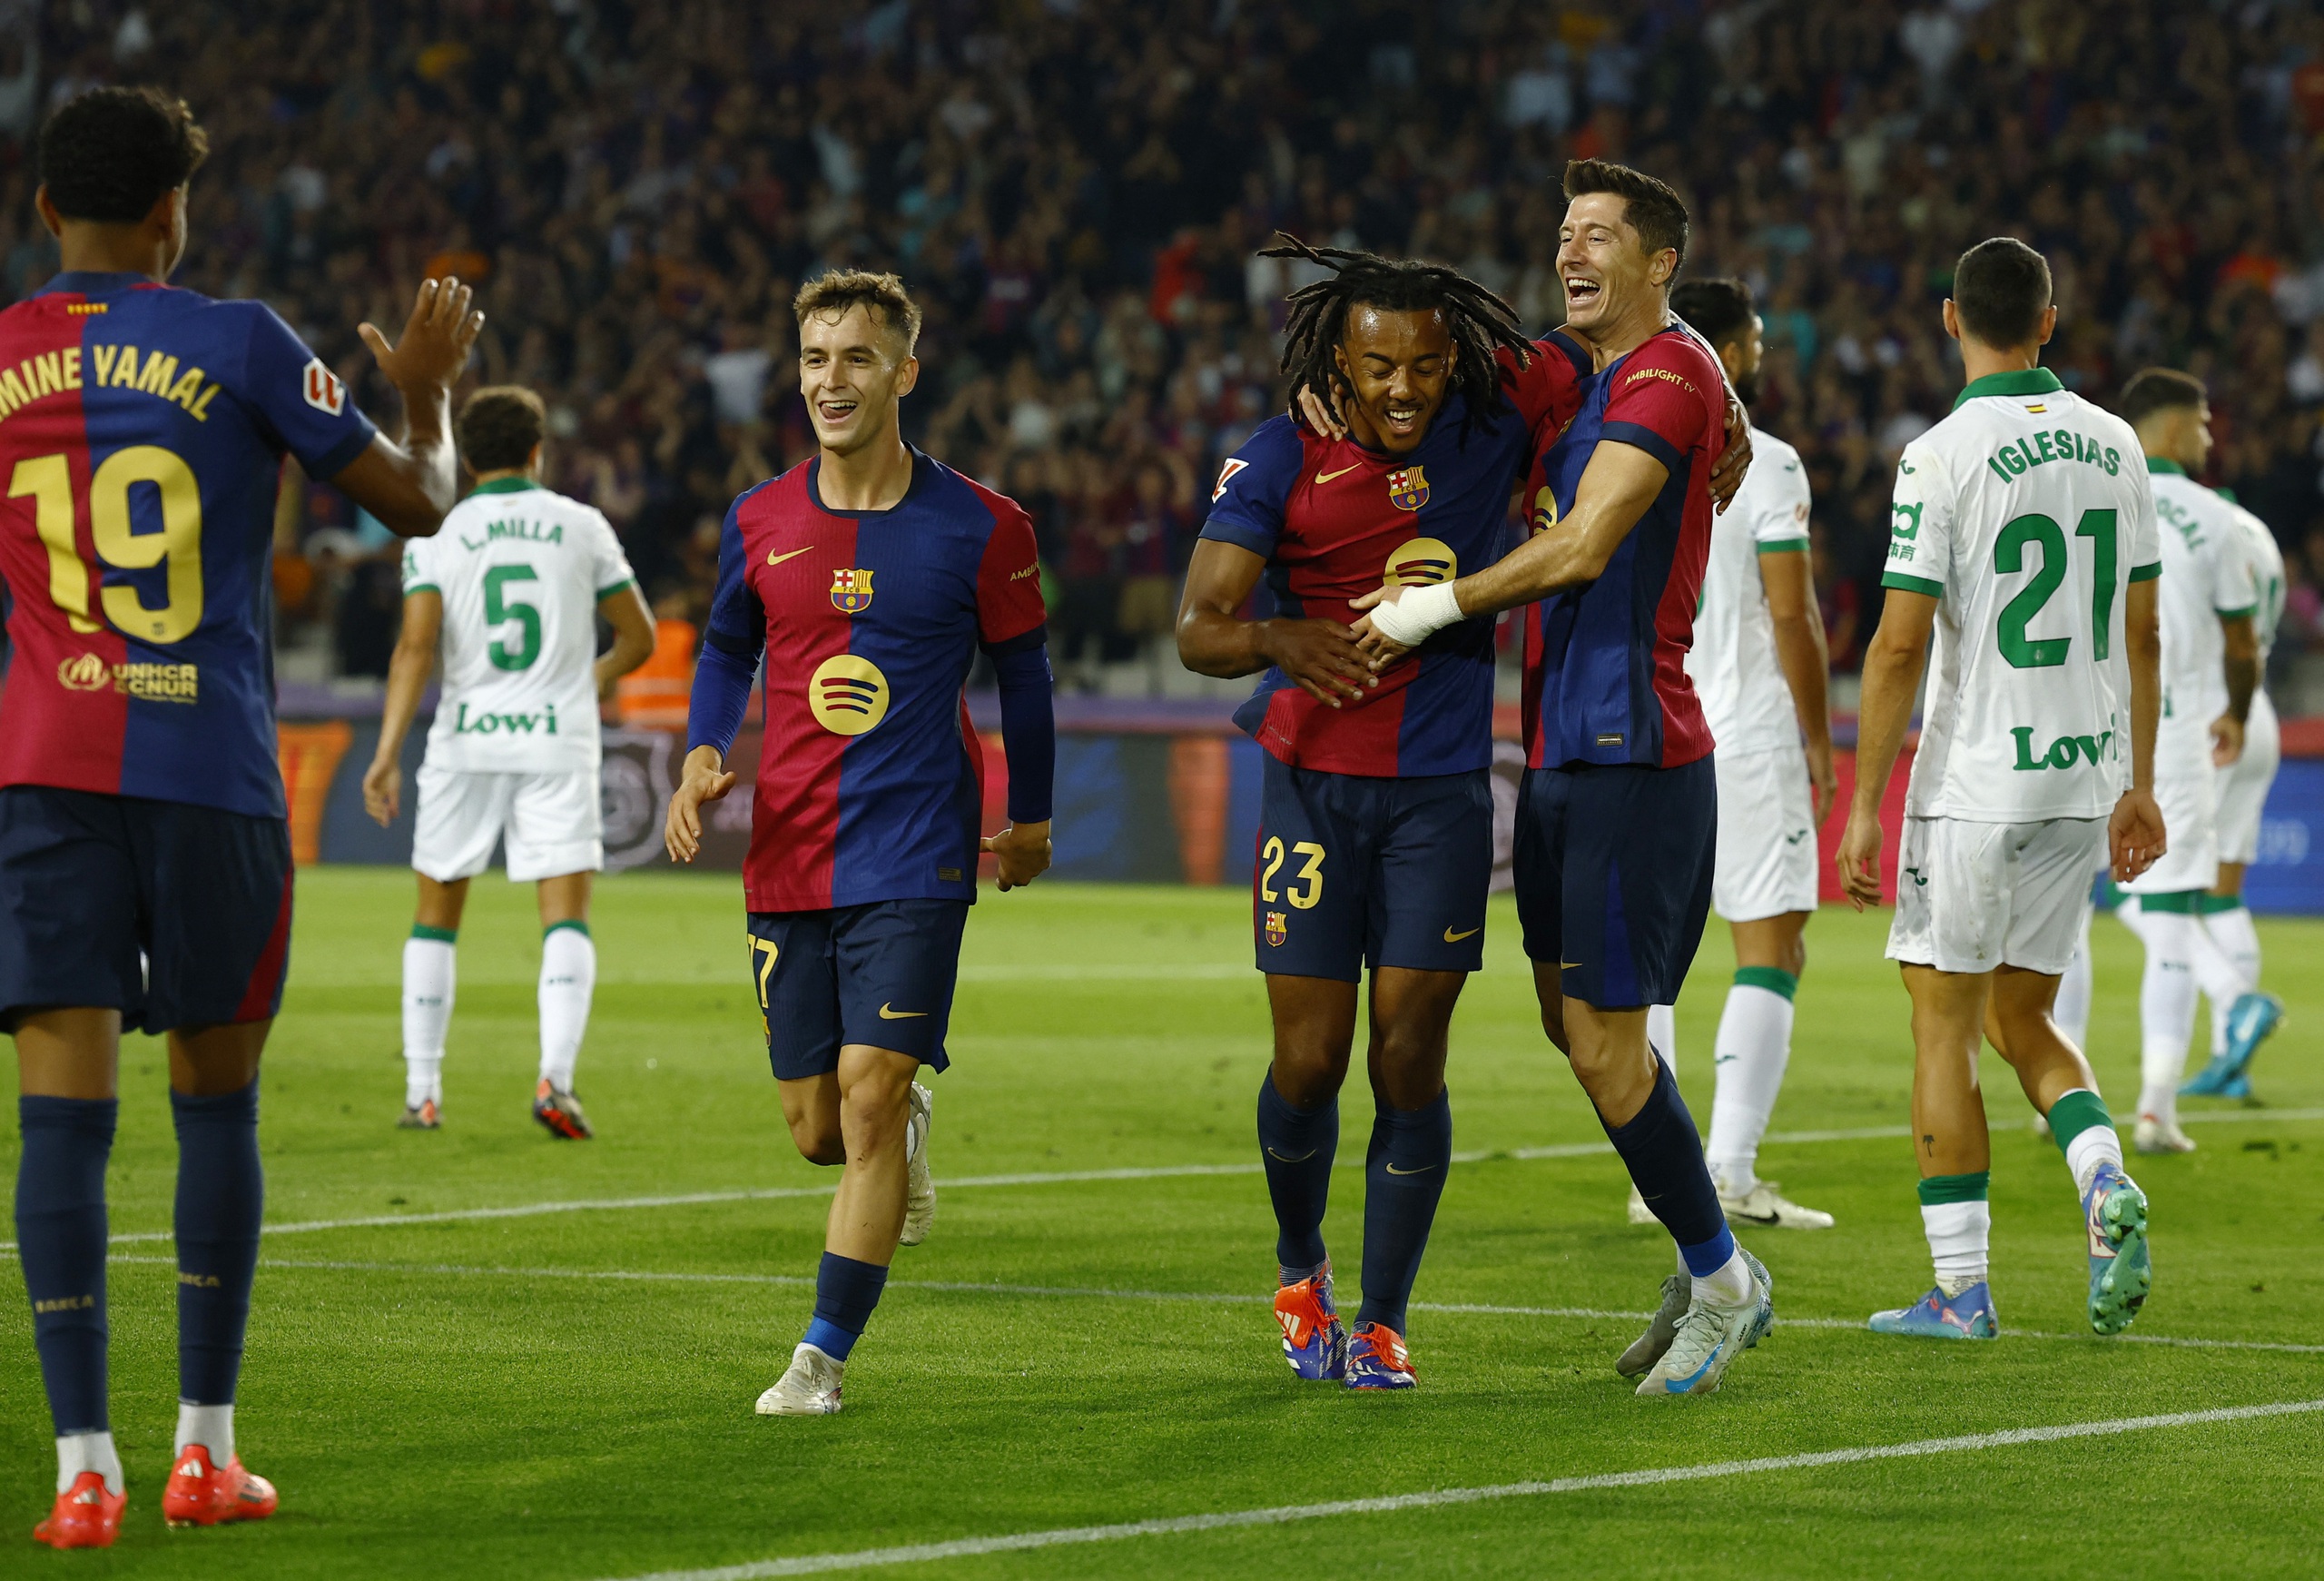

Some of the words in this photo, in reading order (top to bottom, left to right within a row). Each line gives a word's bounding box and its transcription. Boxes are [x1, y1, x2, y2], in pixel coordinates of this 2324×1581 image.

[0, 346, 84, 424] MINE
[94, 344, 222, 422] YAMAL
[1625, 368, 1684, 386] AMBILIGHT
[1684, 381, 1696, 393] tv
[1988, 430, 2121, 484] IGLESIAS
[7, 445, 202, 645] 19
[484, 564, 542, 671] 5
[1994, 509, 2118, 668] 21
[112, 662, 198, 681] UNHCR
[456, 702, 558, 736] Lowi
[2010, 712, 2119, 771] Lowi
[1261, 835, 1326, 909] 23
